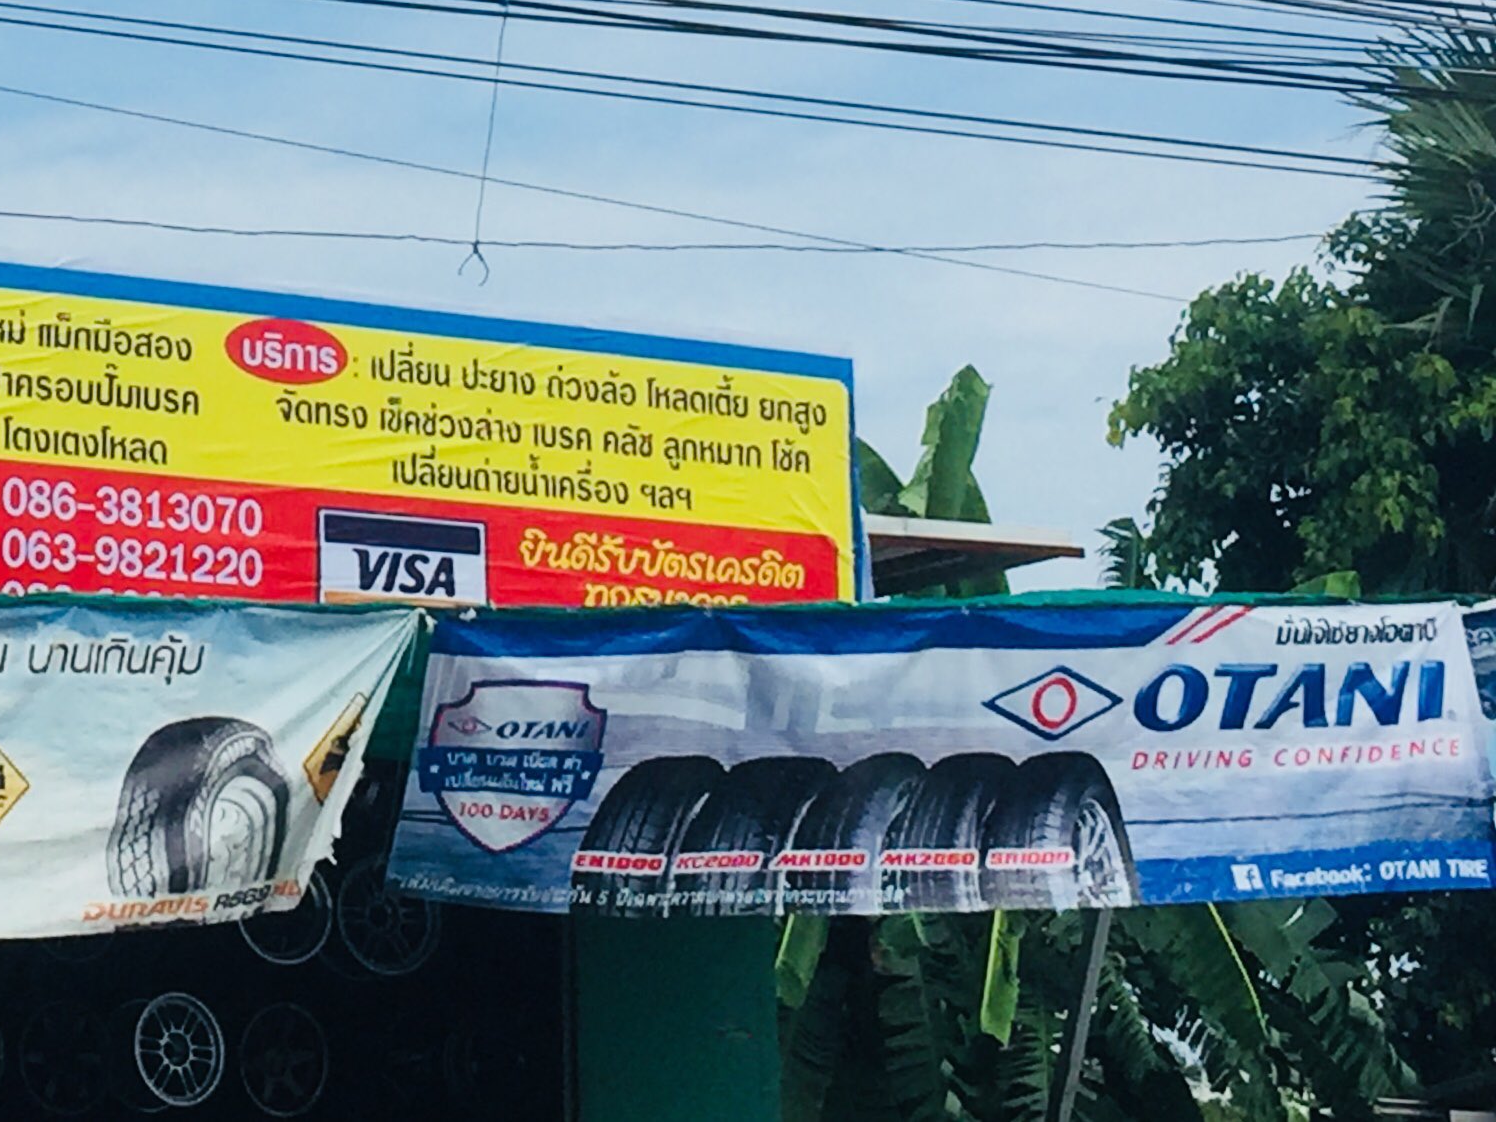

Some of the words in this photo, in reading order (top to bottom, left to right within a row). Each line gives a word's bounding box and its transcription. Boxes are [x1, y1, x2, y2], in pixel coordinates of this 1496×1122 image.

[38, 312, 193, 362] แม็กมือสอง
[242, 331, 338, 374] บริการ
[371, 341, 451, 388] เปลี่ยน
[461, 359, 536, 397] ปะยาง
[546, 364, 637, 407] ถ่วงล้อ
[646, 375, 749, 419] โหลดเตี้ย
[759, 397, 827, 435] ยกสูง
[4, 416, 169, 466] โตงเตงโหลด
[275, 388, 368, 430] จัดทรง
[533, 423, 593, 452] เบรค
[603, 423, 654, 458] คลัช
[663, 436, 762, 471] ลูกหมาก
[771, 439, 811, 474] โช้ค
[392, 445, 629, 505] เปลี่ยนถ่ายน้ำเครื่อง
[640, 482, 693, 511] ฯลฯ
[2, 477, 264, 538] 086-3813070
[2, 528, 264, 588] 063-9821220
[353, 548, 456, 598] VISA
[519, 528, 805, 590] ยินดีรับบัตรเครดิต
[27, 634, 206, 686] นานเกินคุ้ม
[1133, 661, 1447, 733] OTANI
[495, 719, 591, 740] OTANI
[1131, 748, 1253, 771] DRIVING
[1274, 737, 1461, 766] CONFIDENCE
[459, 802, 494, 819] 100
[499, 804, 550, 822] DAYS
[1379, 858, 1441, 880] OTANI
[1444, 858, 1489, 879] TIRE
[83, 894, 210, 922] DURAVIS
